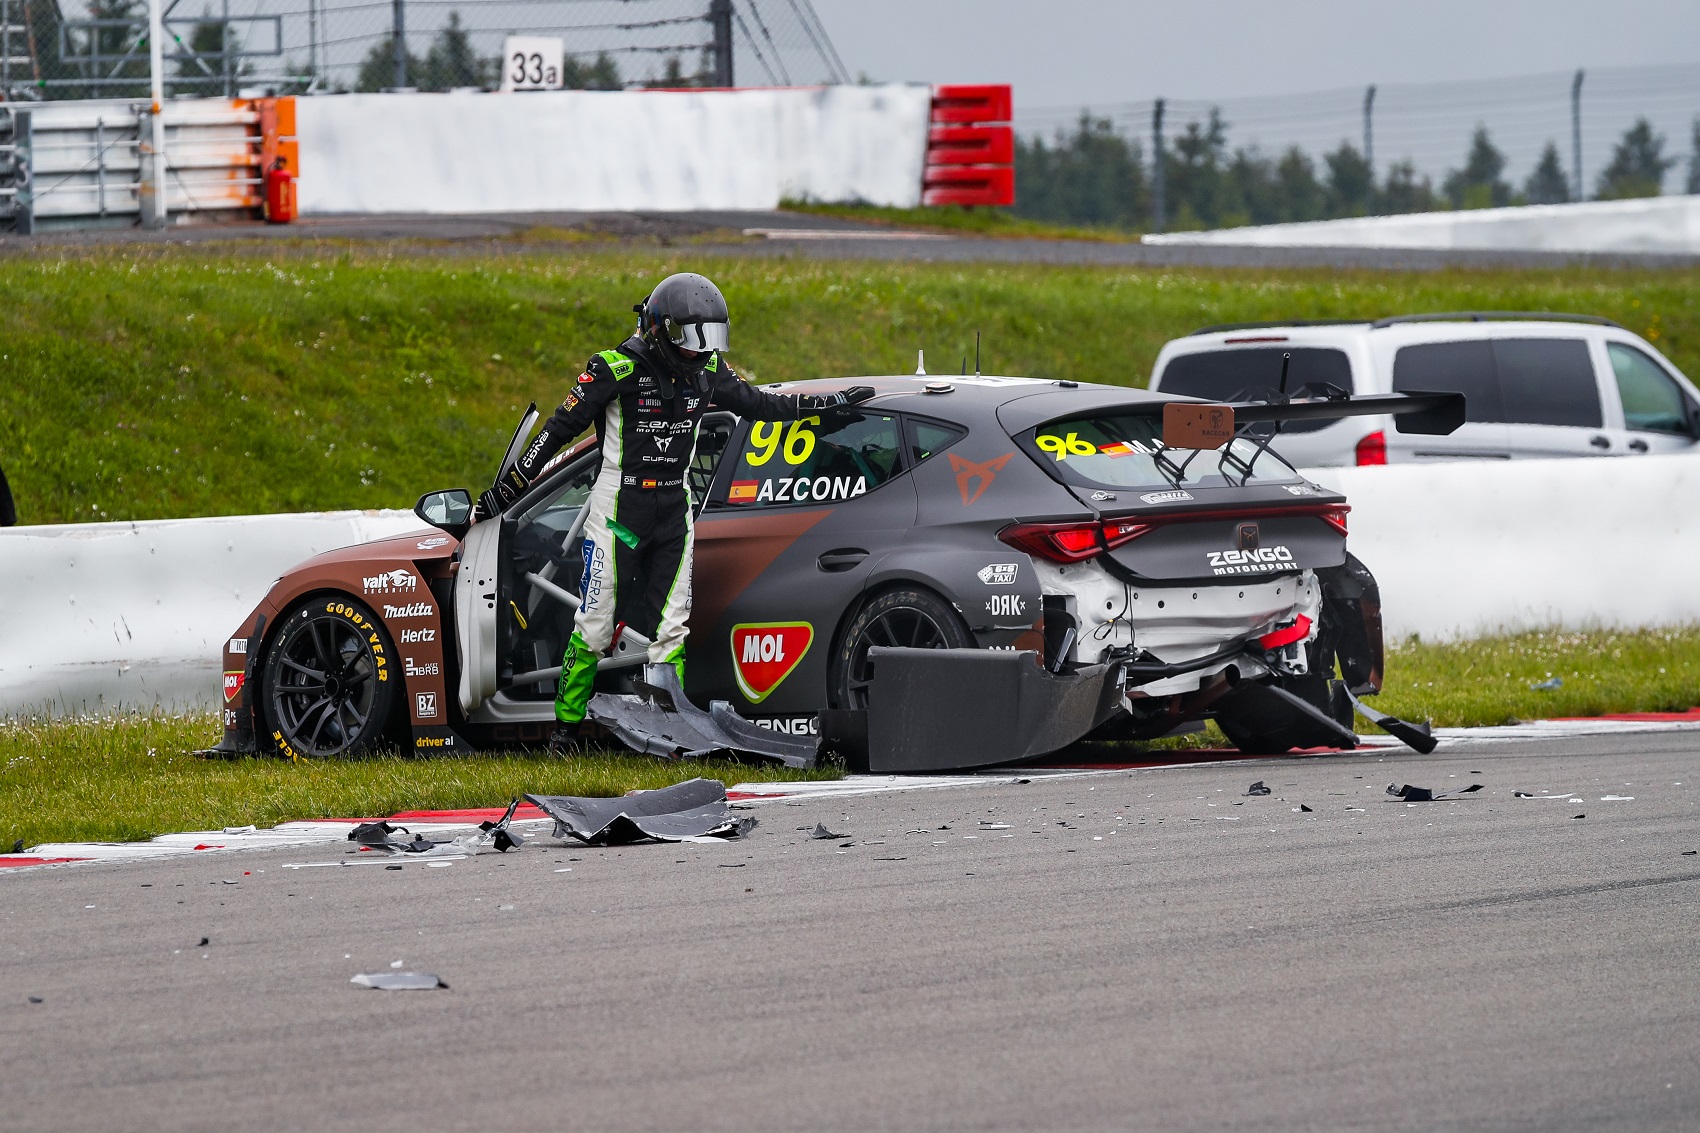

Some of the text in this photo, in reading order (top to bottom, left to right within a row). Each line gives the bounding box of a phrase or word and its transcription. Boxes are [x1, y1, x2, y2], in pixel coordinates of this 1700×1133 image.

[512, 52, 559, 84] 33a
[615, 364, 631, 376] OMP
[745, 415, 821, 467] 96
[1035, 432, 1097, 462] 96
[757, 476, 867, 502] AZCONA
[1213, 562, 1298, 576] MOTORSPORT
[586, 547, 604, 611] GENERAL
[993, 574, 1012, 582] TAXI
[364, 586, 416, 595] SECURITY
[400, 628, 436, 644] Hertz
[741, 634, 785, 664] MOL
[418, 667, 439, 676] BRB
[224, 675, 238, 688] MOL
[418, 694, 435, 711] BZ
